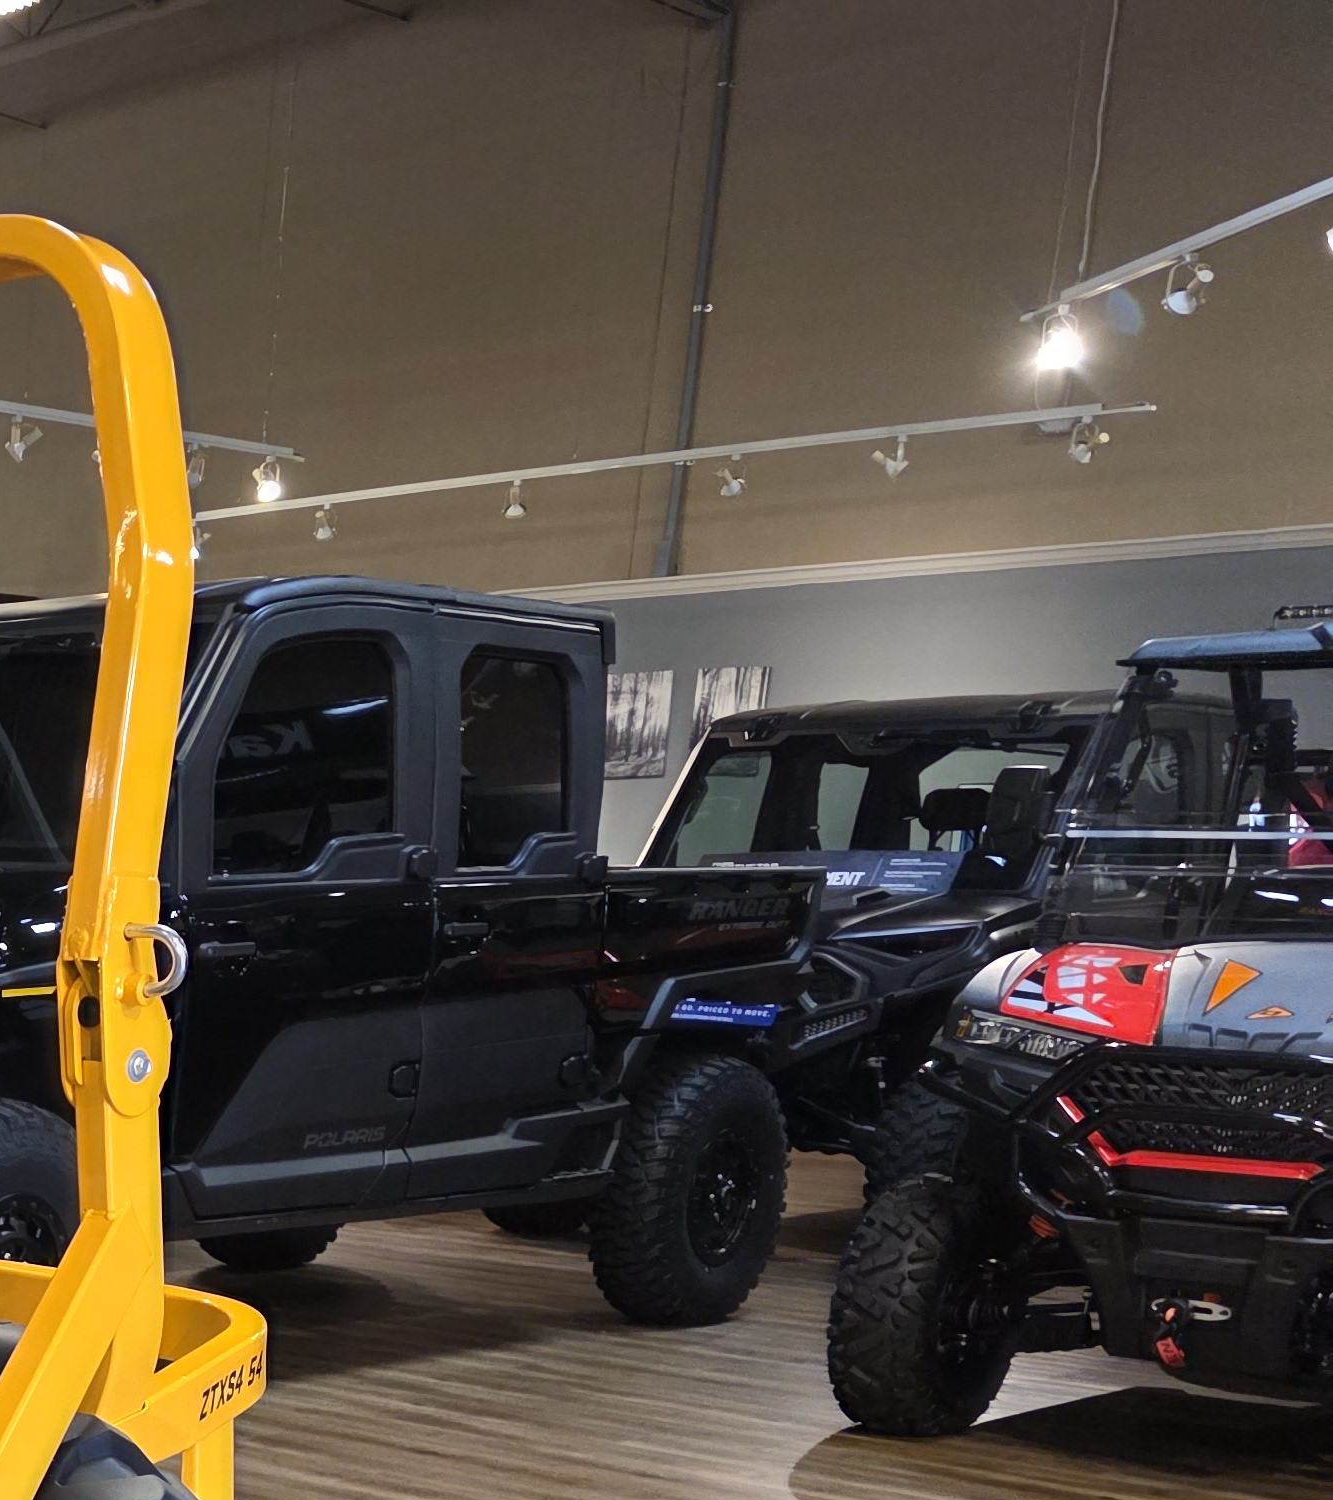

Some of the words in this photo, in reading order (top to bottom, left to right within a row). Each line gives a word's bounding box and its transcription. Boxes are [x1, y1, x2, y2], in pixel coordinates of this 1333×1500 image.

[303, 1125, 386, 1149] POLARIS
[199, 1363, 245, 1421] ZTXS4
[247, 1349, 263, 1387] 54
